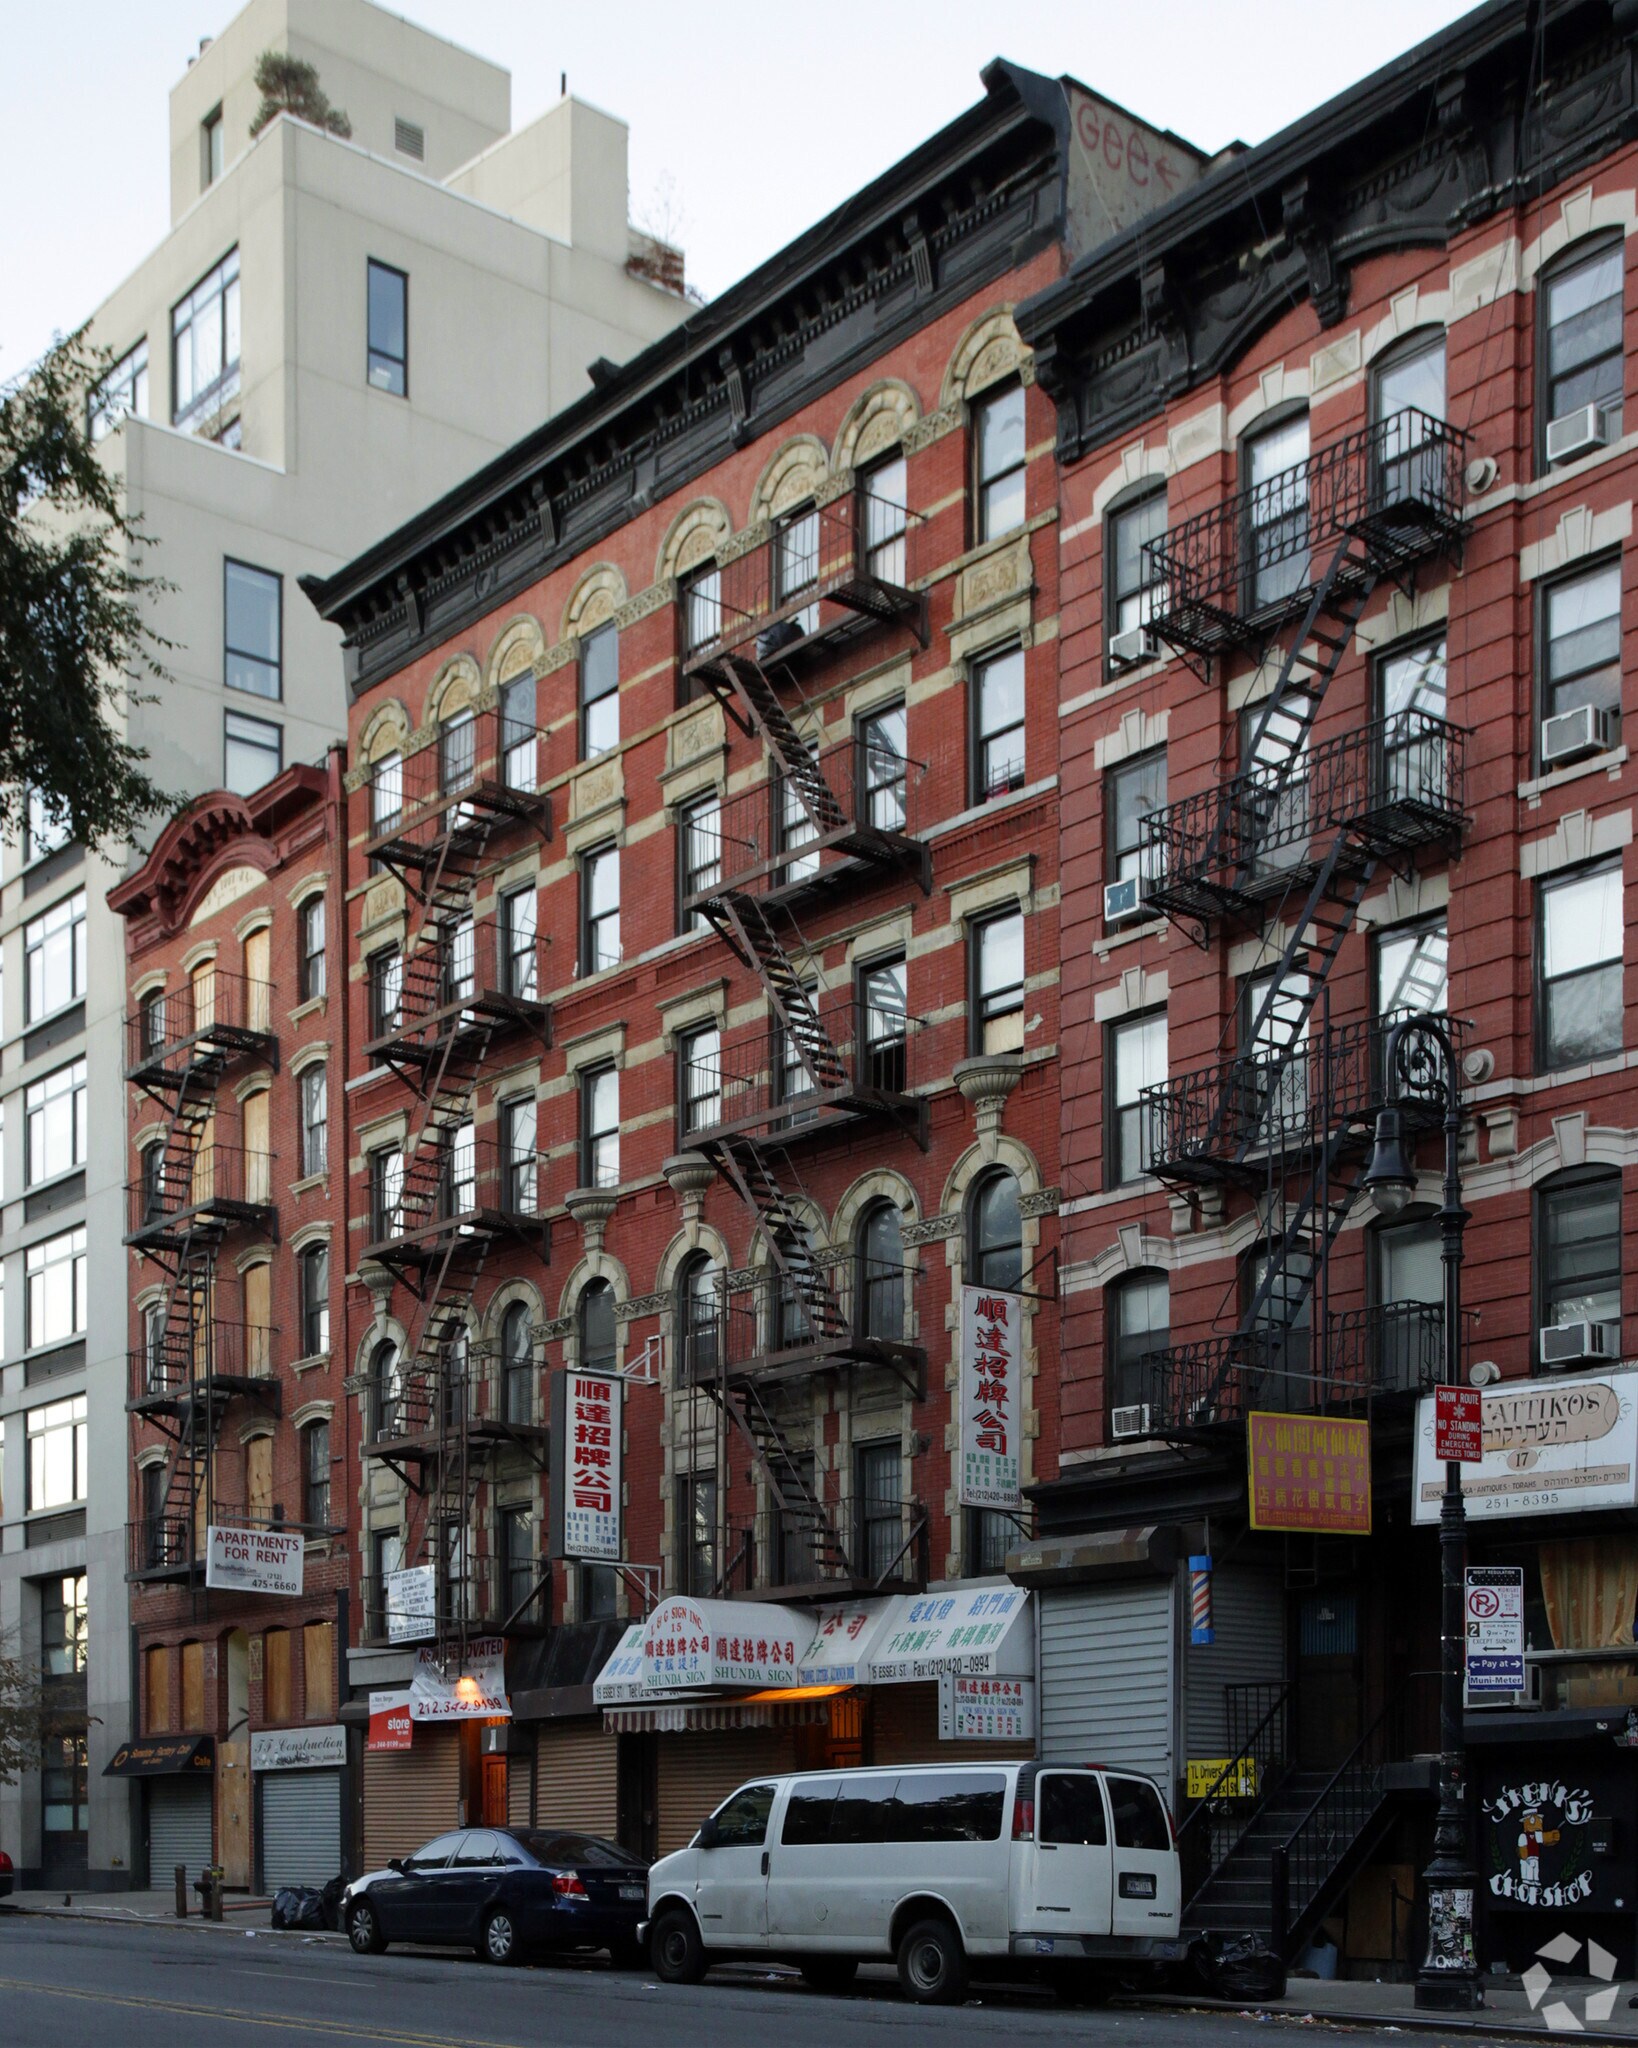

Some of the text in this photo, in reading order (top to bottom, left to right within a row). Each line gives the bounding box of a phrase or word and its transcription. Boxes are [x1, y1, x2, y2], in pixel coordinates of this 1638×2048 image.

[973, 1295, 1012, 1456] 順達招牌公司
[1438, 1391, 1479, 1405] SNOW ROUTE
[1437, 1419, 1480, 1433] NO STANDING
[1448, 1432, 1470, 1440] DURING
[573, 1379, 611, 1513] 順達招牌公司
[1441, 1440, 1477, 1449] EMERGENCY
[1437, 1448, 1480, 1459] VEHICLES TOWED
[1515, 1452, 1529, 1468] 17
[1477, 1483, 1507, 1493] ANTIQUES
[1512, 1480, 1537, 1489] TORAHS
[214, 1531, 299, 1551] APARTMENTS
[225, 1546, 288, 1565] FOR RENT
[252, 1579, 297, 1592] 475-6660
[671, 1606, 687, 1619] SIGN
[671, 1623, 682, 1632] 15
[1469, 1624, 1478, 1637] 2
[716, 1637, 795, 1665] 順達招牌公司
[1481, 1660, 1497, 1669] Pay
[715, 1666, 793, 1682] SHUNDA SIGN
[878, 1665, 896, 1678] ESSEX
[647, 1670, 706, 1687] SHUNDA SIGN
[418, 1697, 503, 1715] 212.344.9199
[387, 1717, 410, 1730] store
[279, 1736, 343, 1752] Construction
[1192, 1784, 1200, 1795] 17
